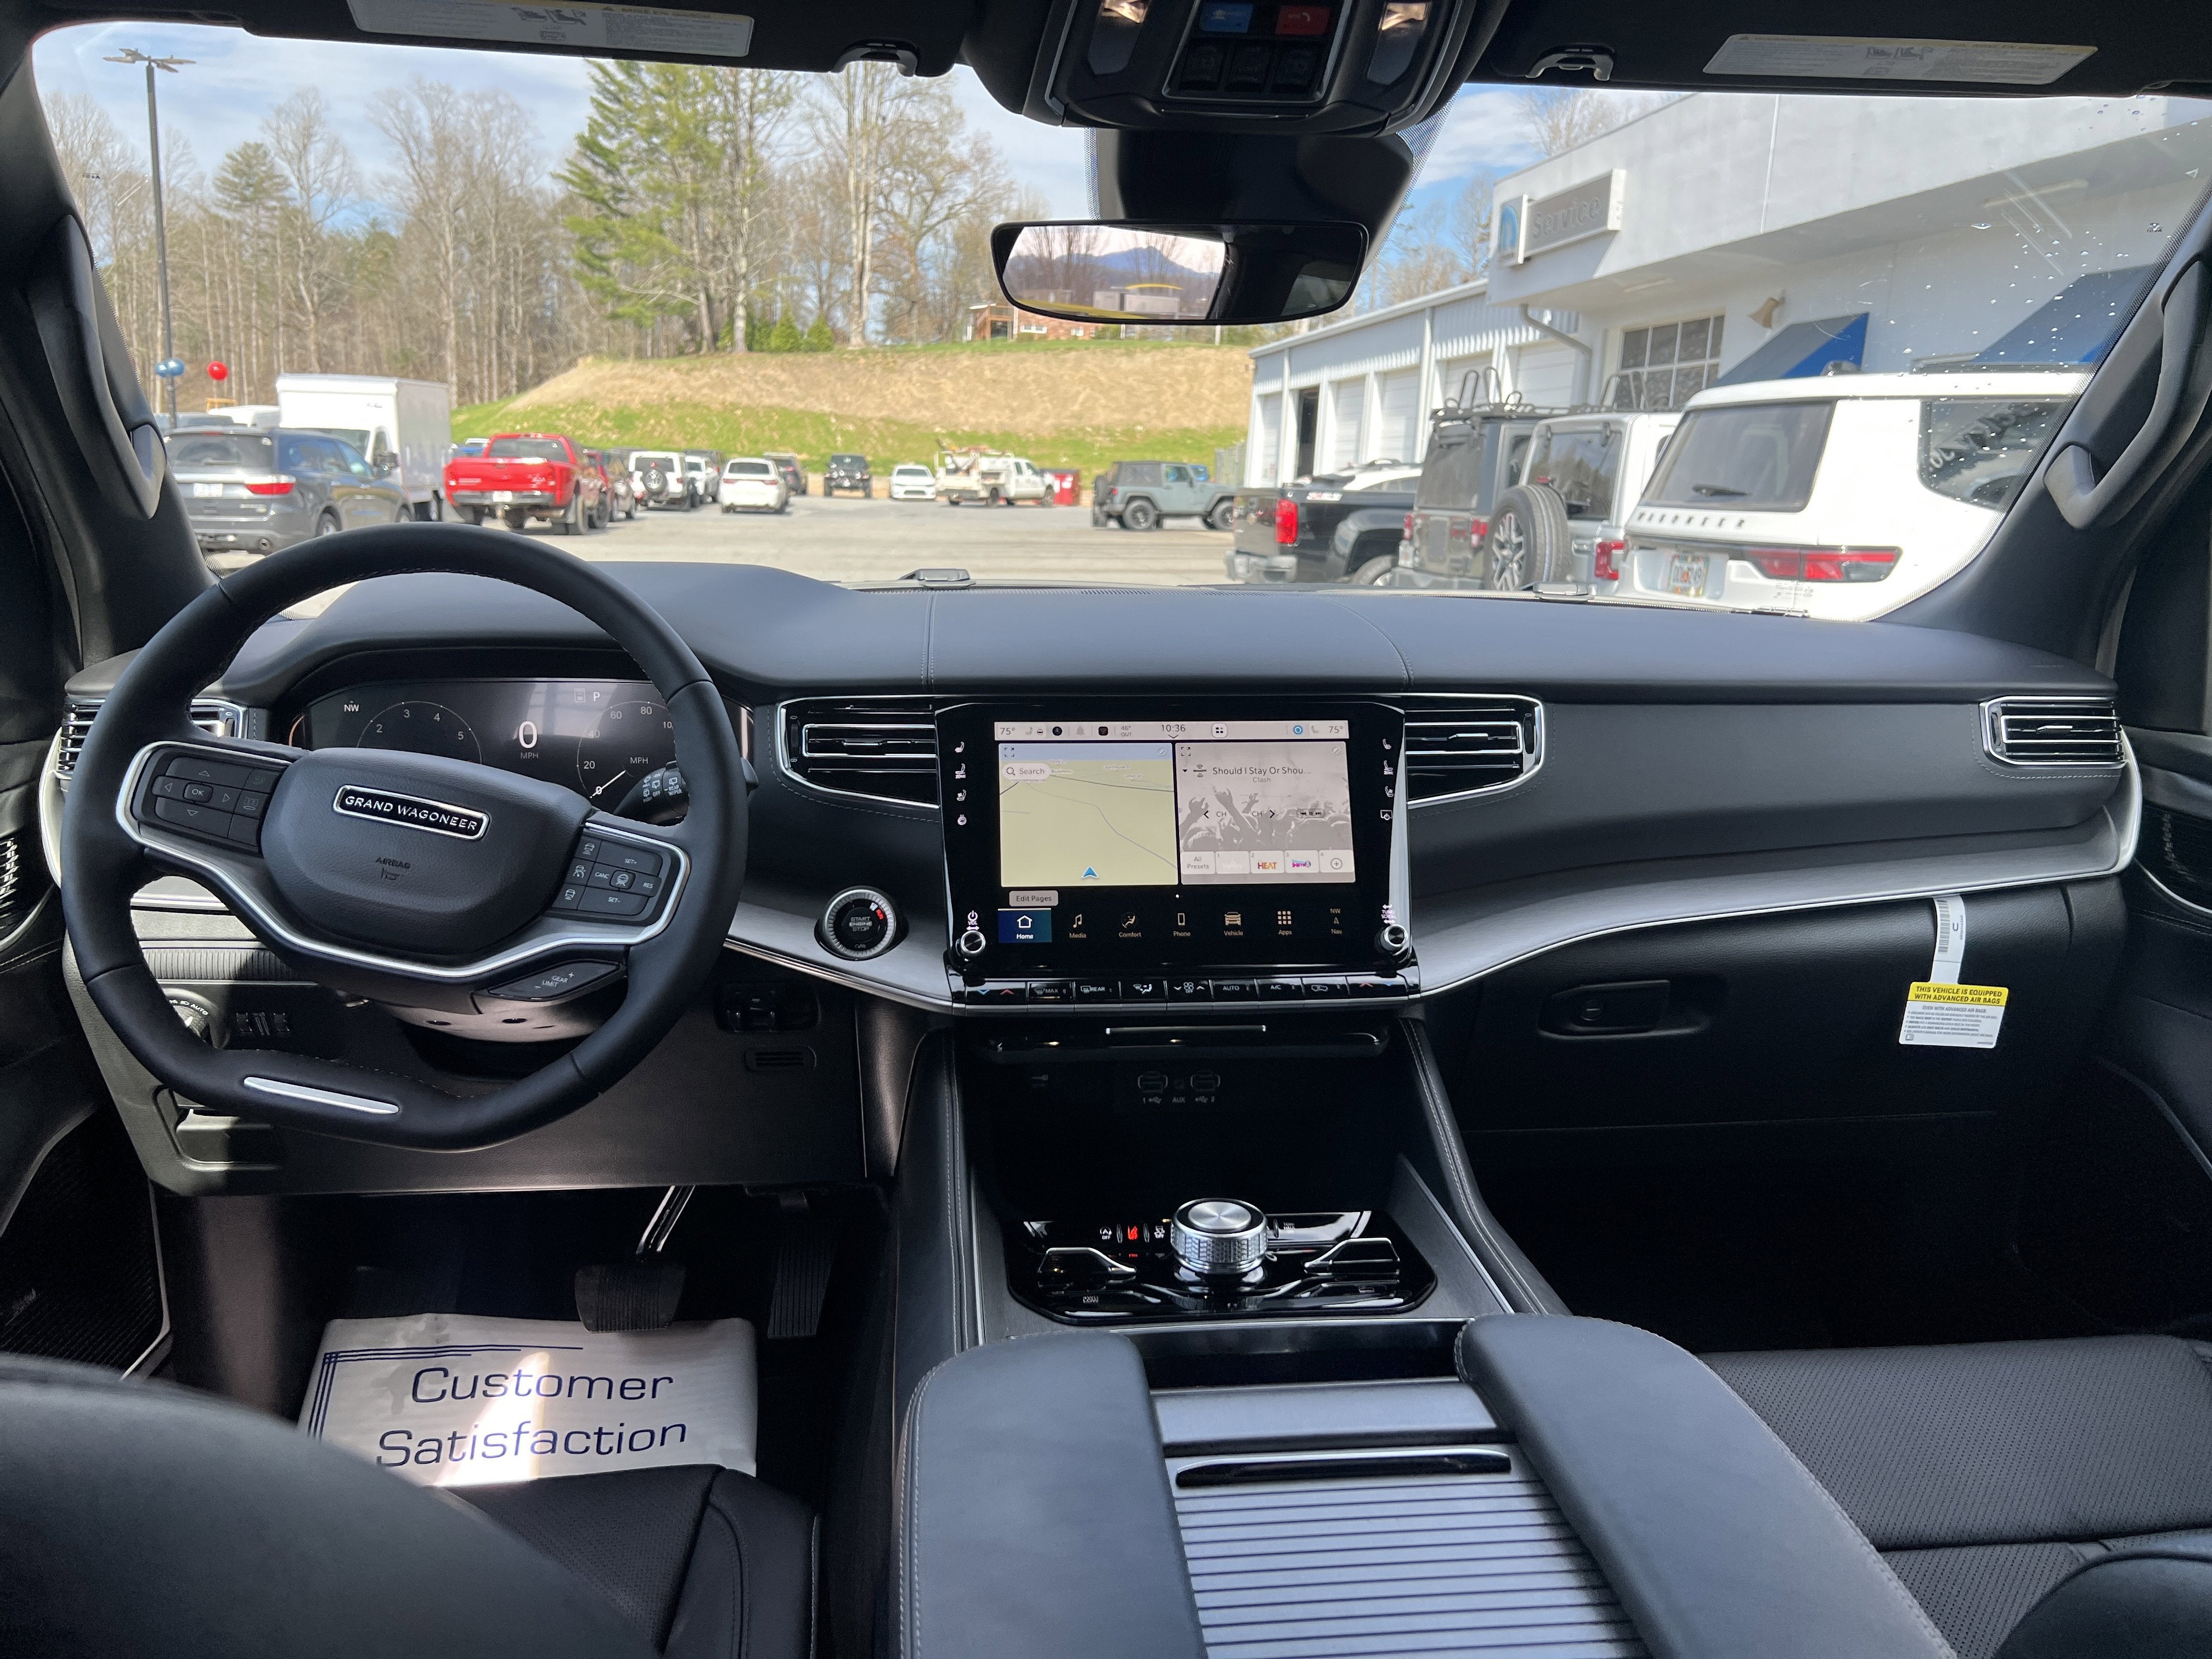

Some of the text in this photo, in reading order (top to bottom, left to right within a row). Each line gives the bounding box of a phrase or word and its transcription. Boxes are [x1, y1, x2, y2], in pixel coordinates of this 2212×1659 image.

[1532, 196, 1601, 240] Service
[593, 691, 601, 702] P
[343, 703, 360, 713] NW
[640, 706, 653, 715] 80
[403, 709, 410, 718] 3
[433, 713, 441, 722] 4
[610, 710, 623, 720] 60
[376, 724, 383, 733] 2
[1000, 727, 1015, 735] 75°
[1161, 724, 1186, 732] 10:36
[1329, 725, 1344, 733] 75°
[458, 731, 464, 740] 5
[518, 721, 538, 749] 0
[589, 730, 601, 739] 40
[520, 752, 539, 760] MPH
[583, 760, 596, 770] 20
[1249, 767, 1267, 776] Stay
[345, 795, 478, 831] GRAND WAGONEER
[375, 856, 411, 870] AIRBAG
[1031, 895, 1052, 903] Pages
[1952, 922, 1959, 932] U
[541, 979, 558, 988] LIMIT
[552, 975, 569, 983] GEAR
[190, 1003, 209, 1015] AUTO
[412, 1367, 674, 1403] Customer
[376, 1421, 686, 1468] Satisfaction
